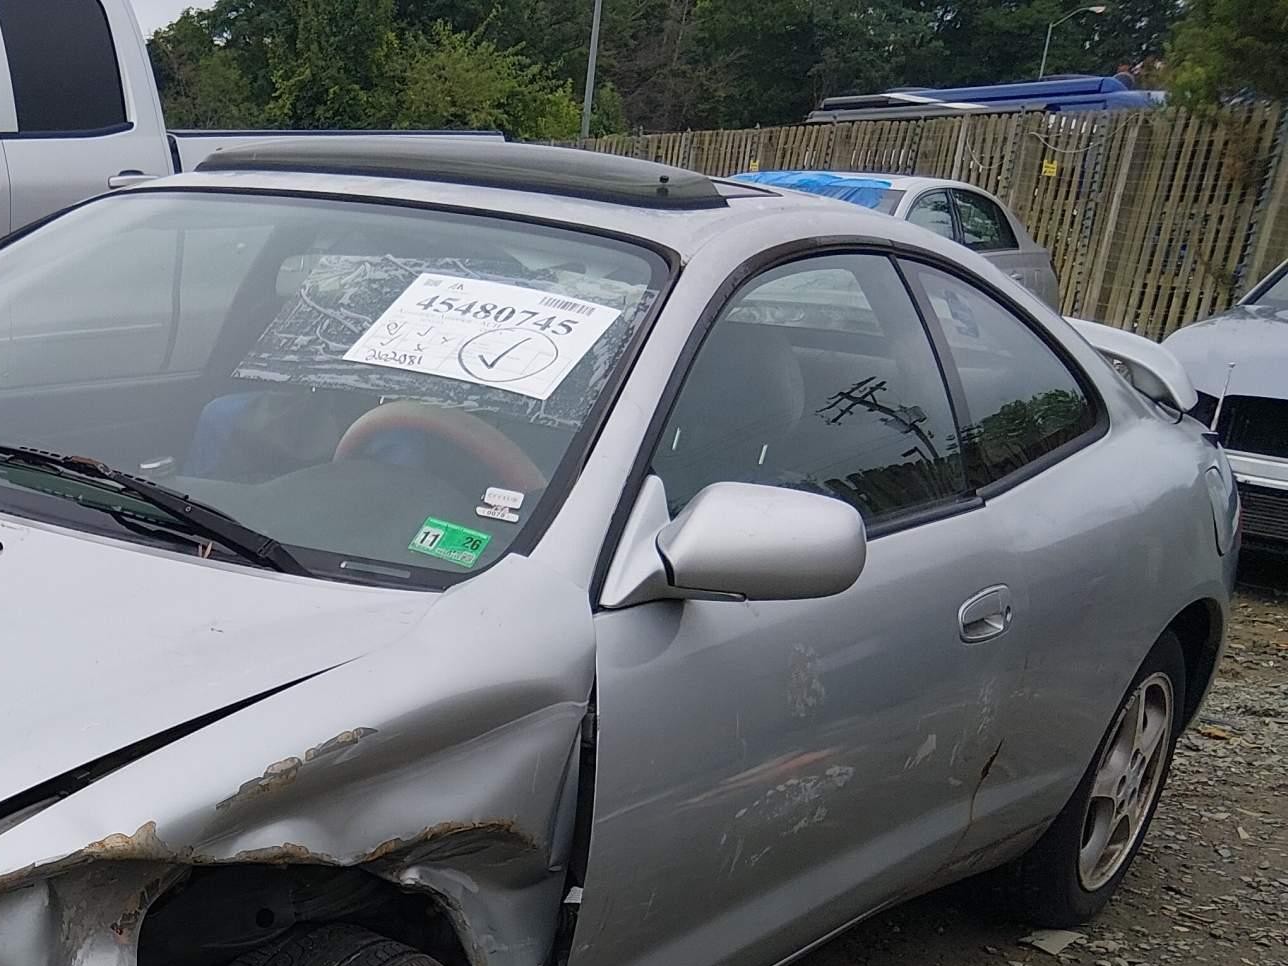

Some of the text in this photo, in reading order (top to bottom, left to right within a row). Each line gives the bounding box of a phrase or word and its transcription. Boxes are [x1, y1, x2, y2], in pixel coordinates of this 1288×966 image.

[415, 295, 580, 336] 45480745
[420, 531, 482, 551] 11 26
